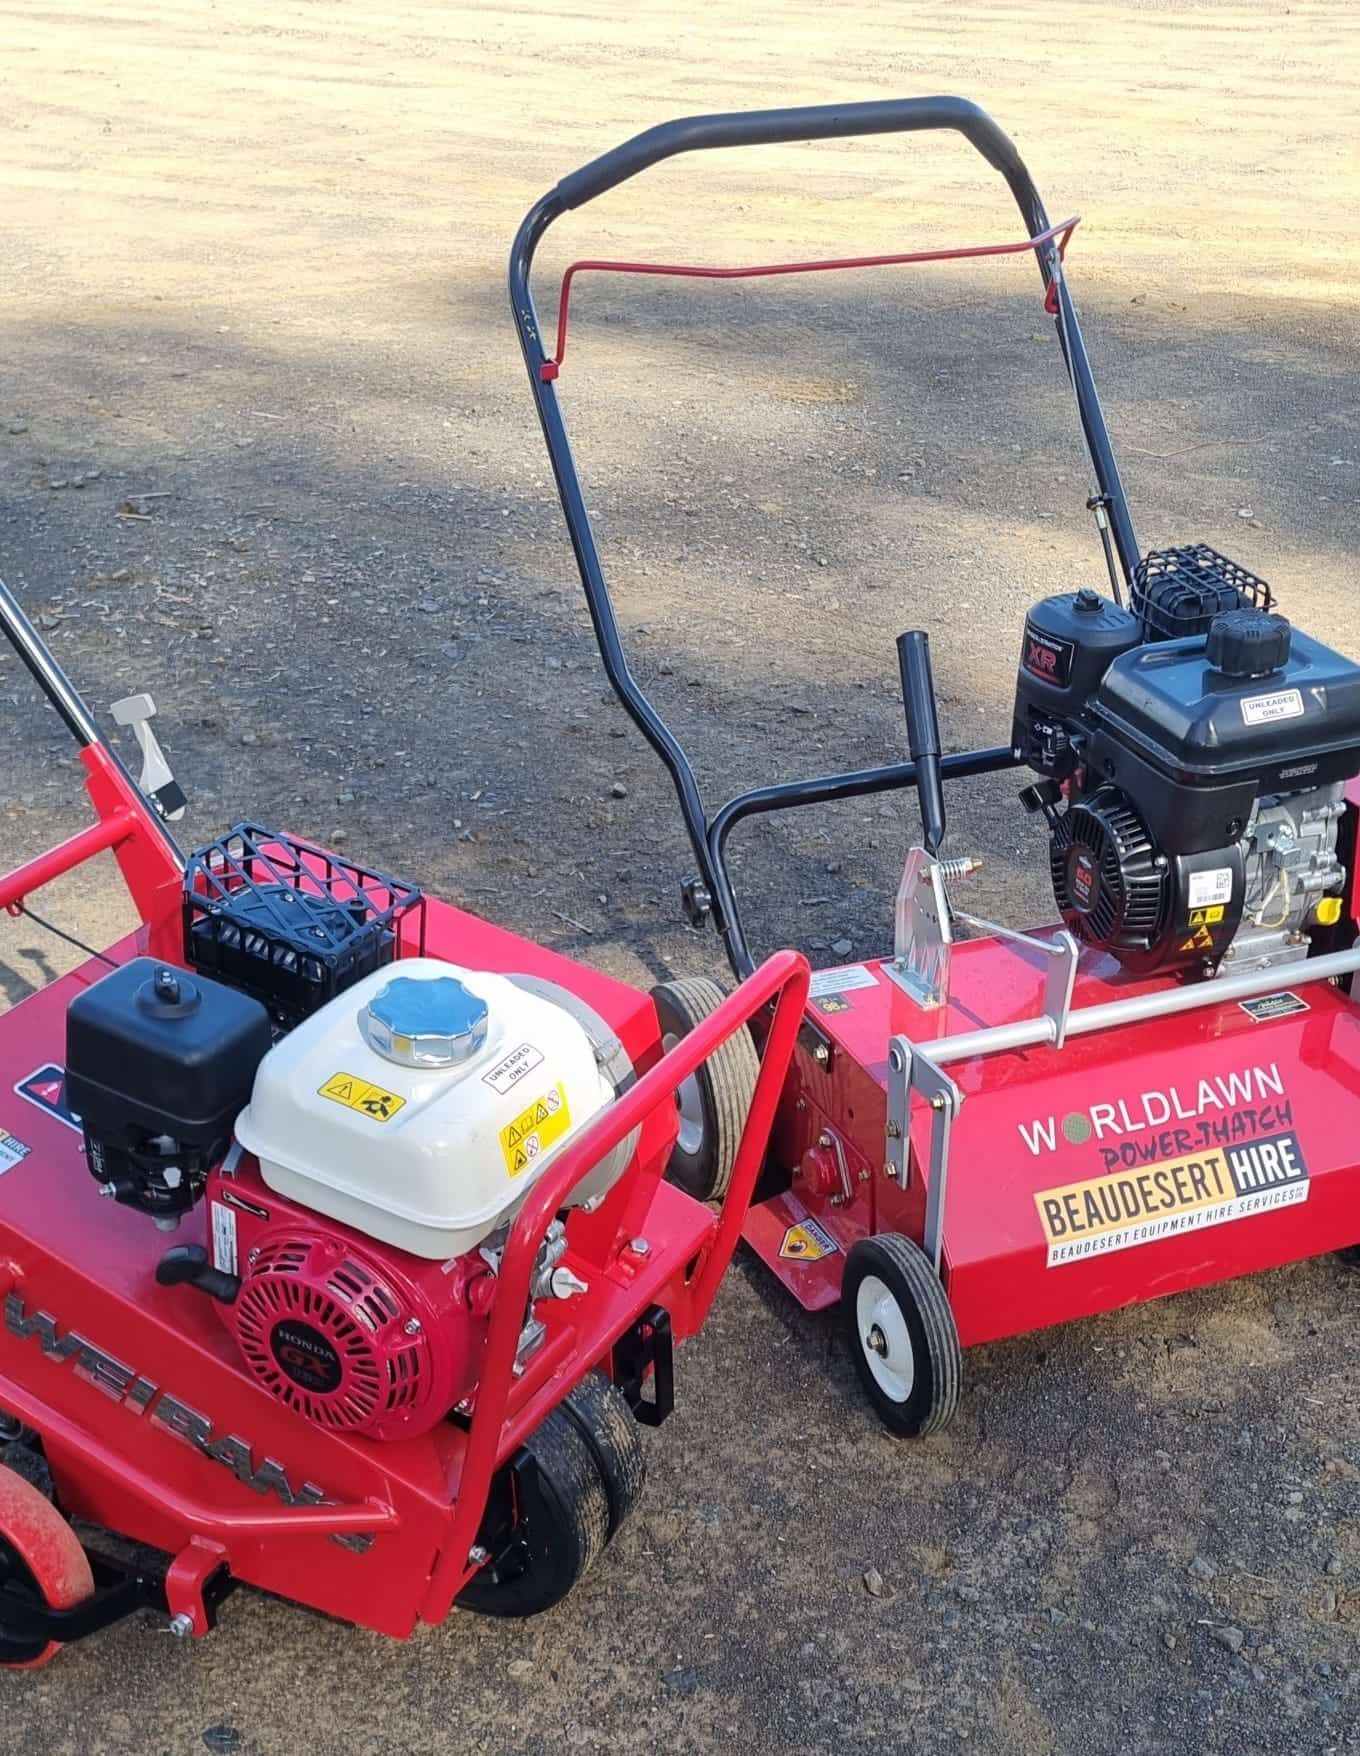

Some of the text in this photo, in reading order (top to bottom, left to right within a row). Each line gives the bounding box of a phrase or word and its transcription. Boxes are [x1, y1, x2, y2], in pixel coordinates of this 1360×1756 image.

[1248, 695, 1295, 710] UNLEADED
[1262, 707, 1285, 717] ONLY
[488, 1046, 531, 1082] UNLEADED
[508, 1061, 531, 1080] ONLY
[1018, 1063, 1285, 1156] WORLDLAWN
[1099, 1100, 1294, 1174] POWER-THATCH
[1042, 1137, 1303, 1238] BEAUDESERT HIRE
[1052, 1231, 1130, 1261] BEAUDESERT
[1132, 1213, 1202, 1241] EQUIPMENT
[1206, 1205, 1234, 1222] HIRE
[1239, 1189, 1295, 1214] SERVICES
[278, 1328, 336, 1361] HONDA
[279, 1345, 331, 1380] GX
